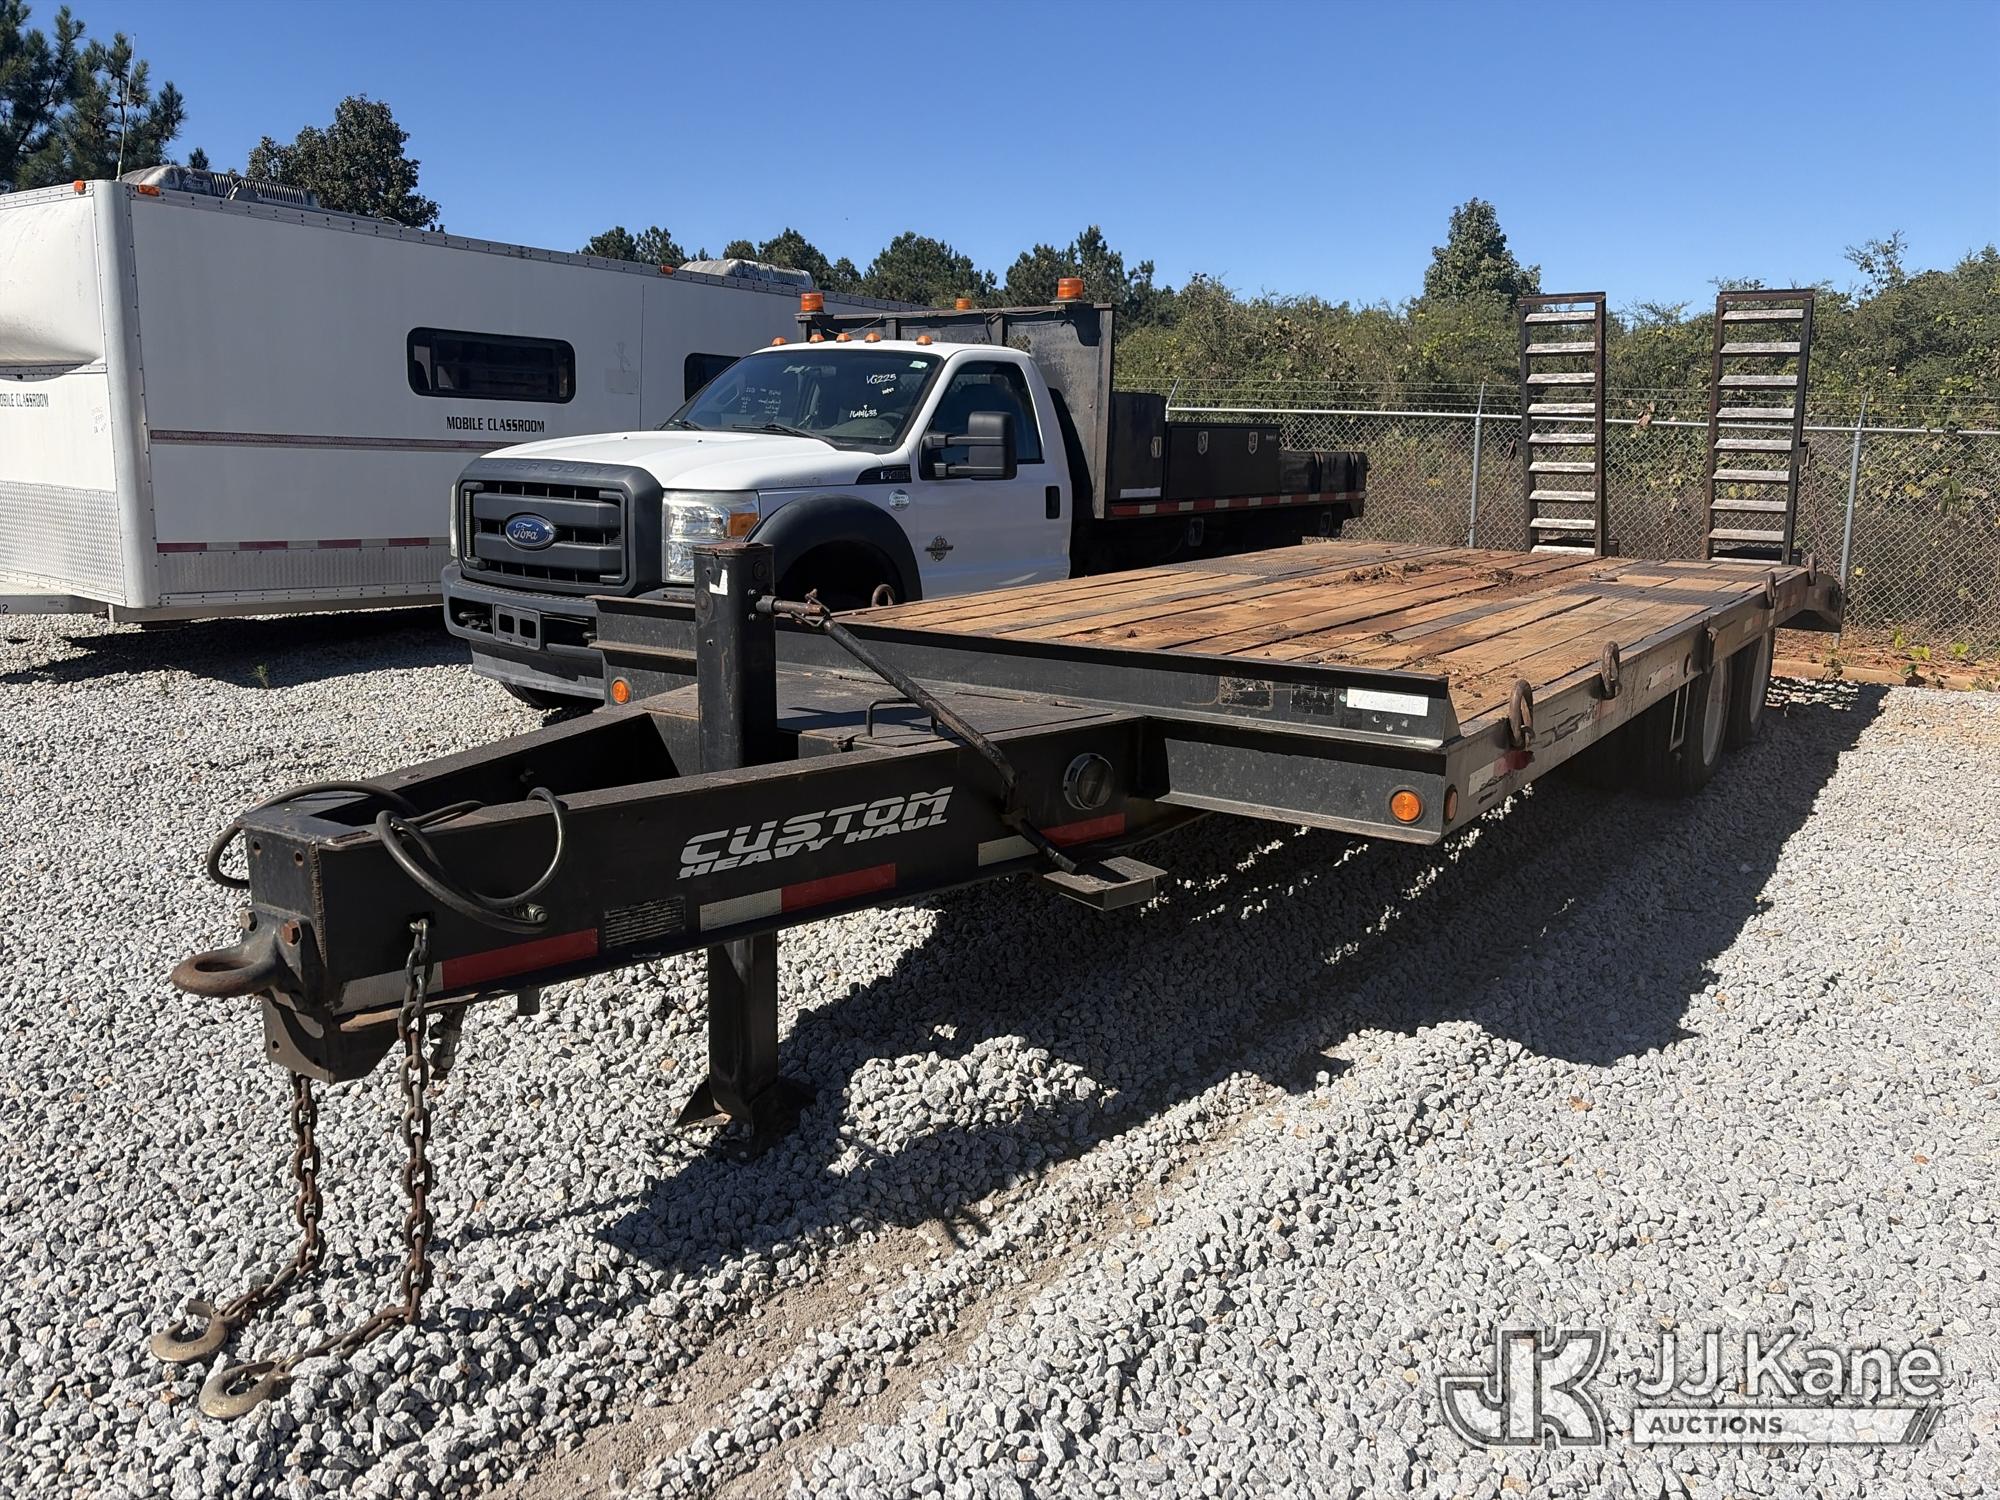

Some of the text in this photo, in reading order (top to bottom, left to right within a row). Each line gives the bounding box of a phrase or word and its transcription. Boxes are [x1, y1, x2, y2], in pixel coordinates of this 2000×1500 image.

[15, 393, 49, 407] CLASSROOM
[446, 416, 545, 433] MOBILE CLASSROOM
[547, 463, 609, 475] DUTY
[511, 522, 540, 542] Ford
[679, 786, 954, 866] CUSTOM
[675, 813, 949, 881] HEAVY HAUL
